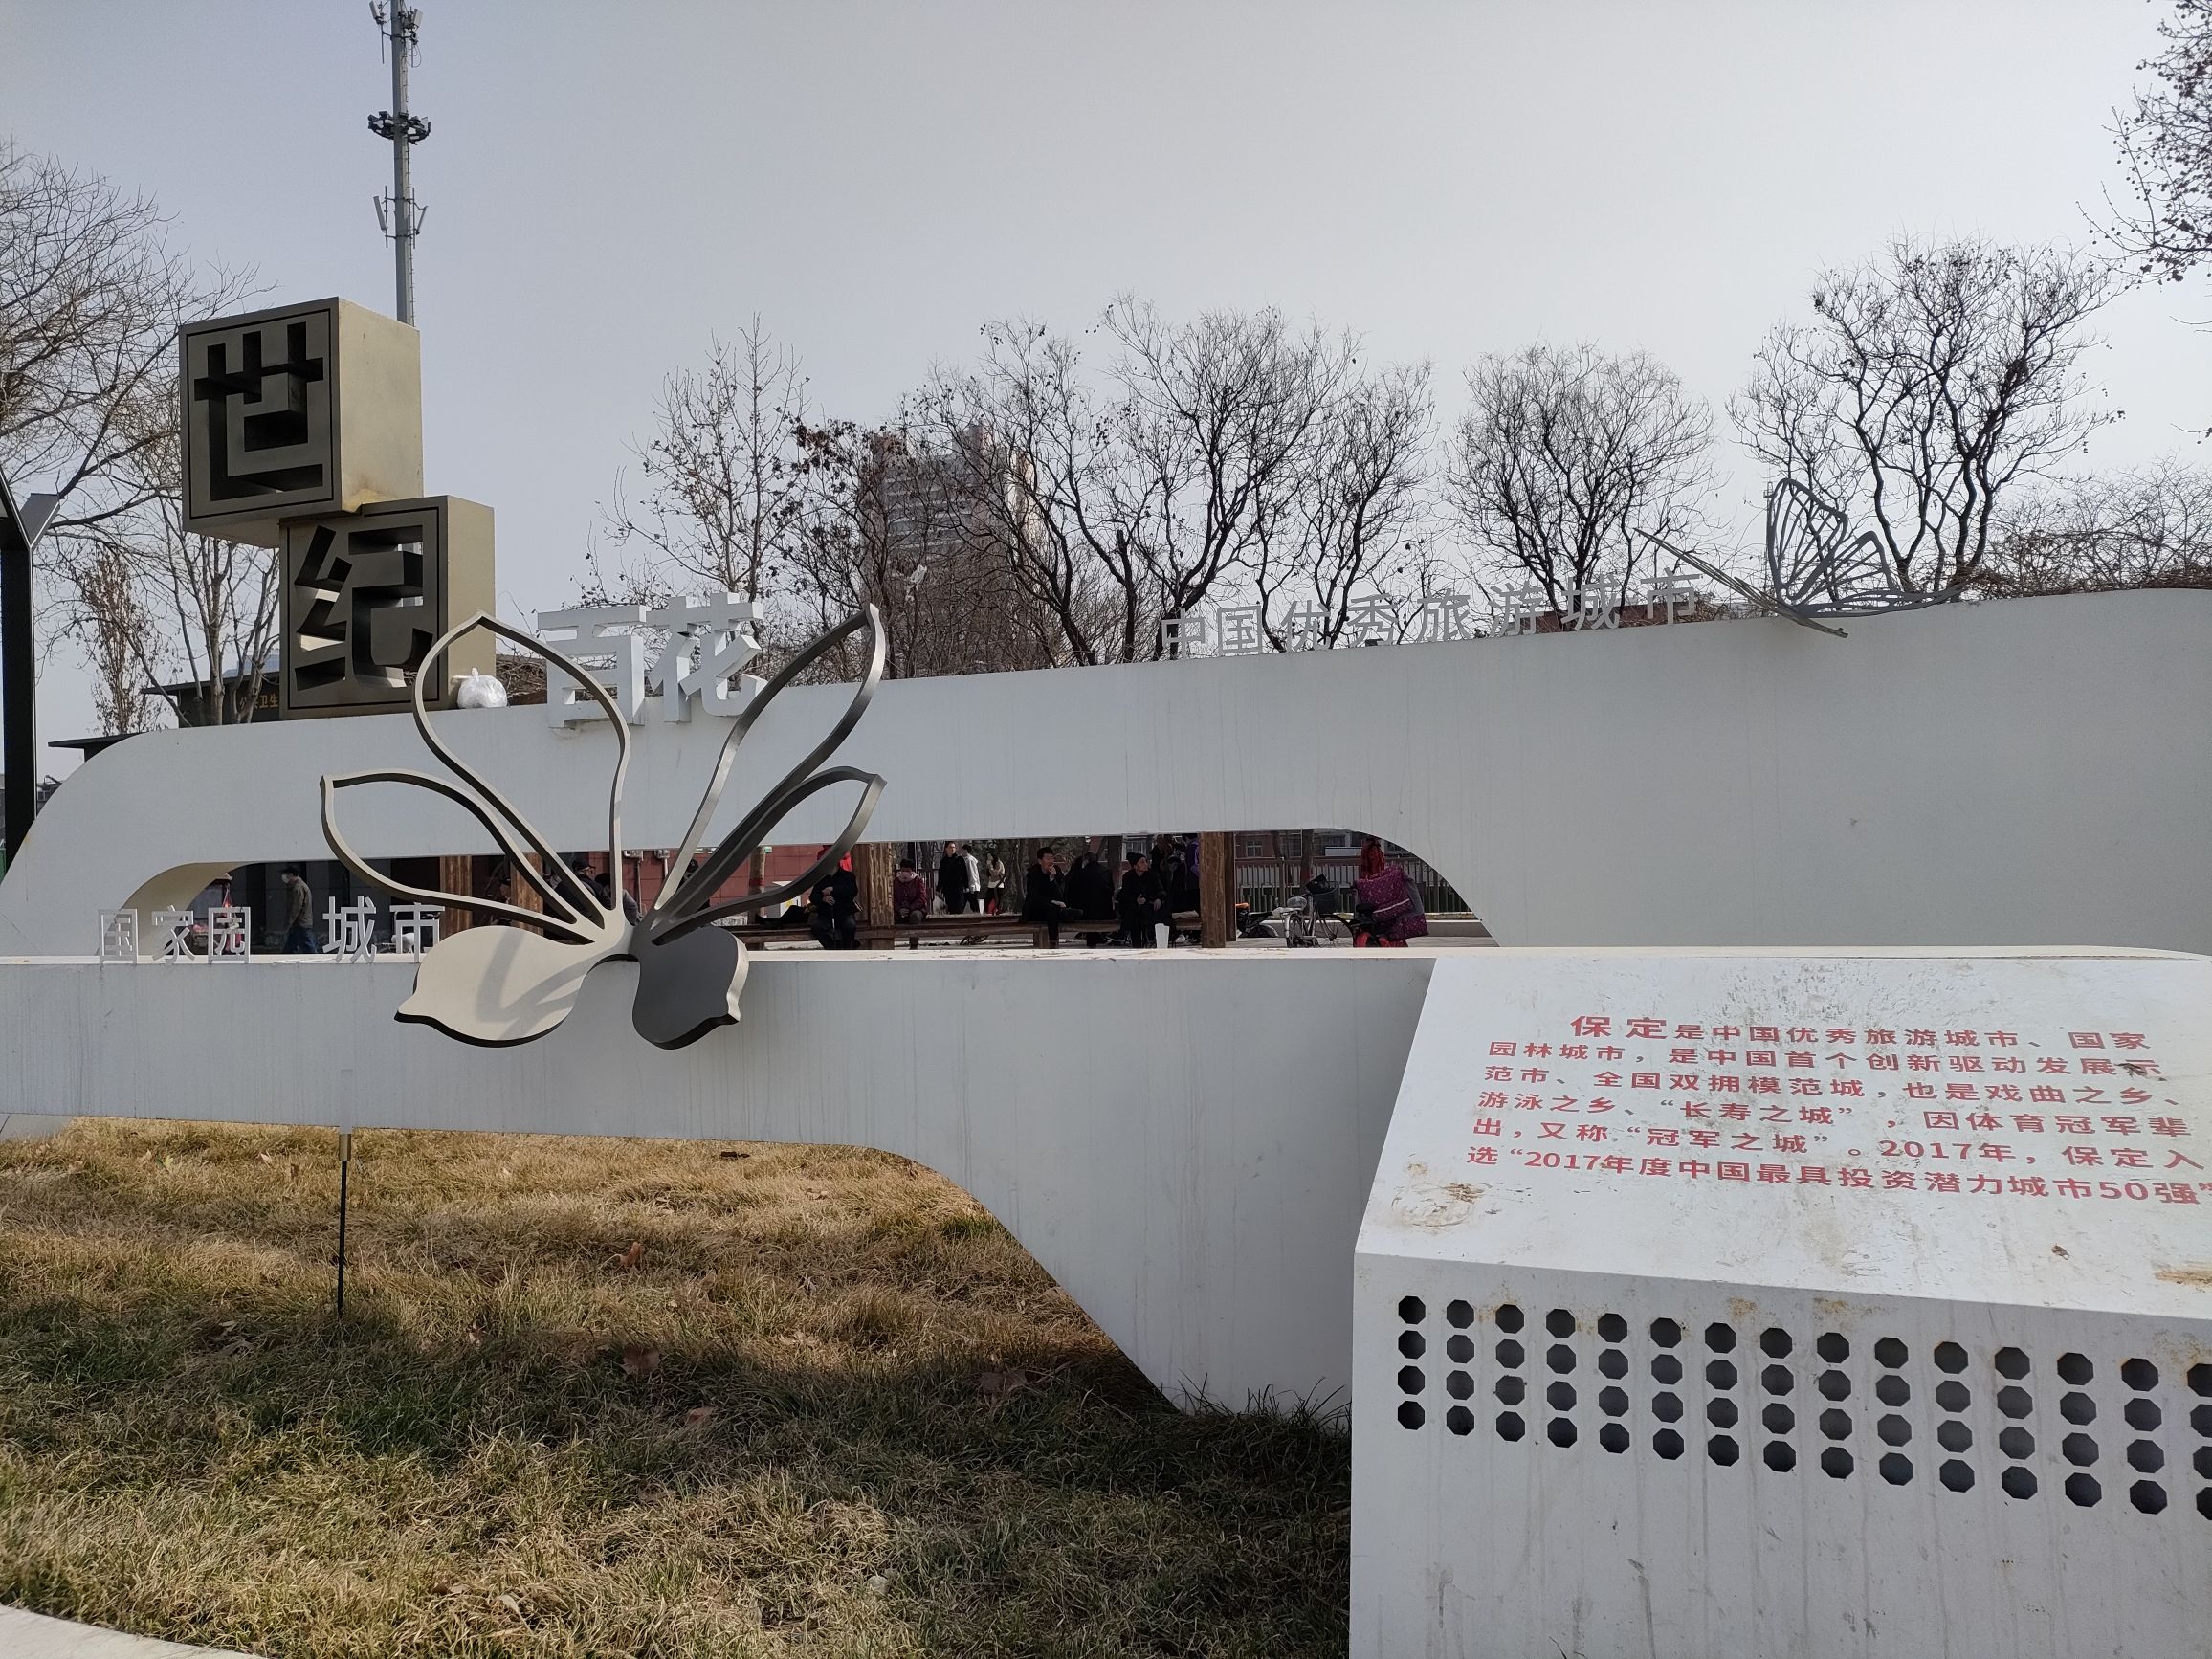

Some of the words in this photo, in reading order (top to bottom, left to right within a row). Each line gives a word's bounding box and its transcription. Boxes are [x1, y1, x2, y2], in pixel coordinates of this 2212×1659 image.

[537, 591, 768, 729] 百花
[1161, 567, 1701, 660] 中国优秀旅游城市
[322, 895, 446, 964] 城市
